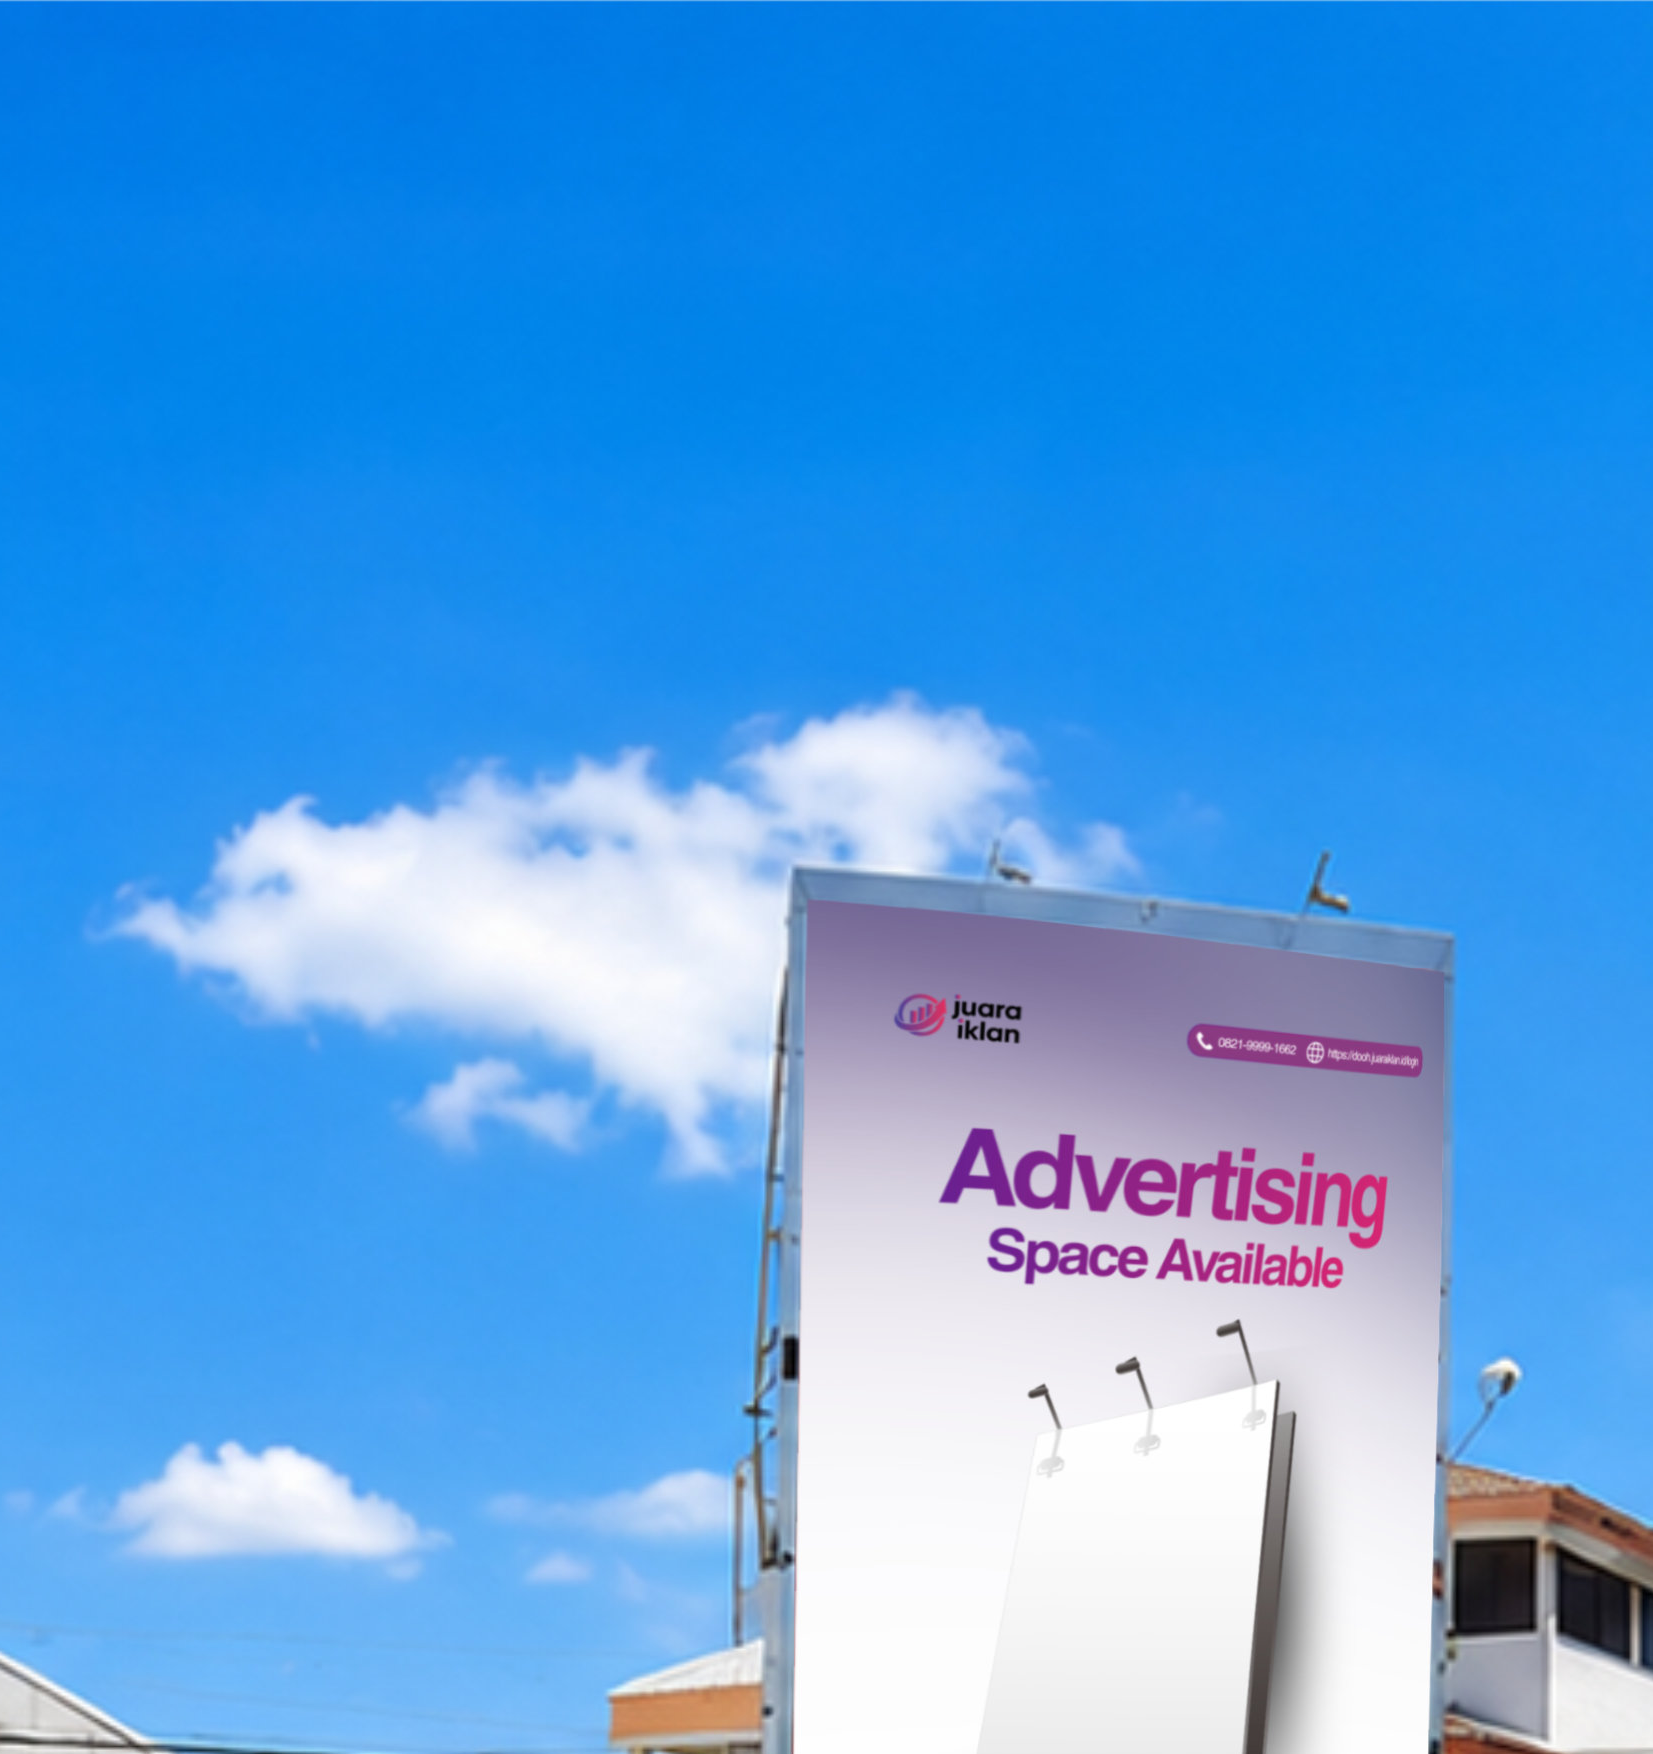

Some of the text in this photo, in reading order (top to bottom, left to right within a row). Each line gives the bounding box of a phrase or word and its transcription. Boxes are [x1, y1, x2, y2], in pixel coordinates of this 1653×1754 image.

[952, 994, 1022, 1021] juara
[957, 1018, 1020, 1044] iklan
[939, 1128, 1388, 1249] Advertising
[987, 1227, 1344, 1289] Space Available
